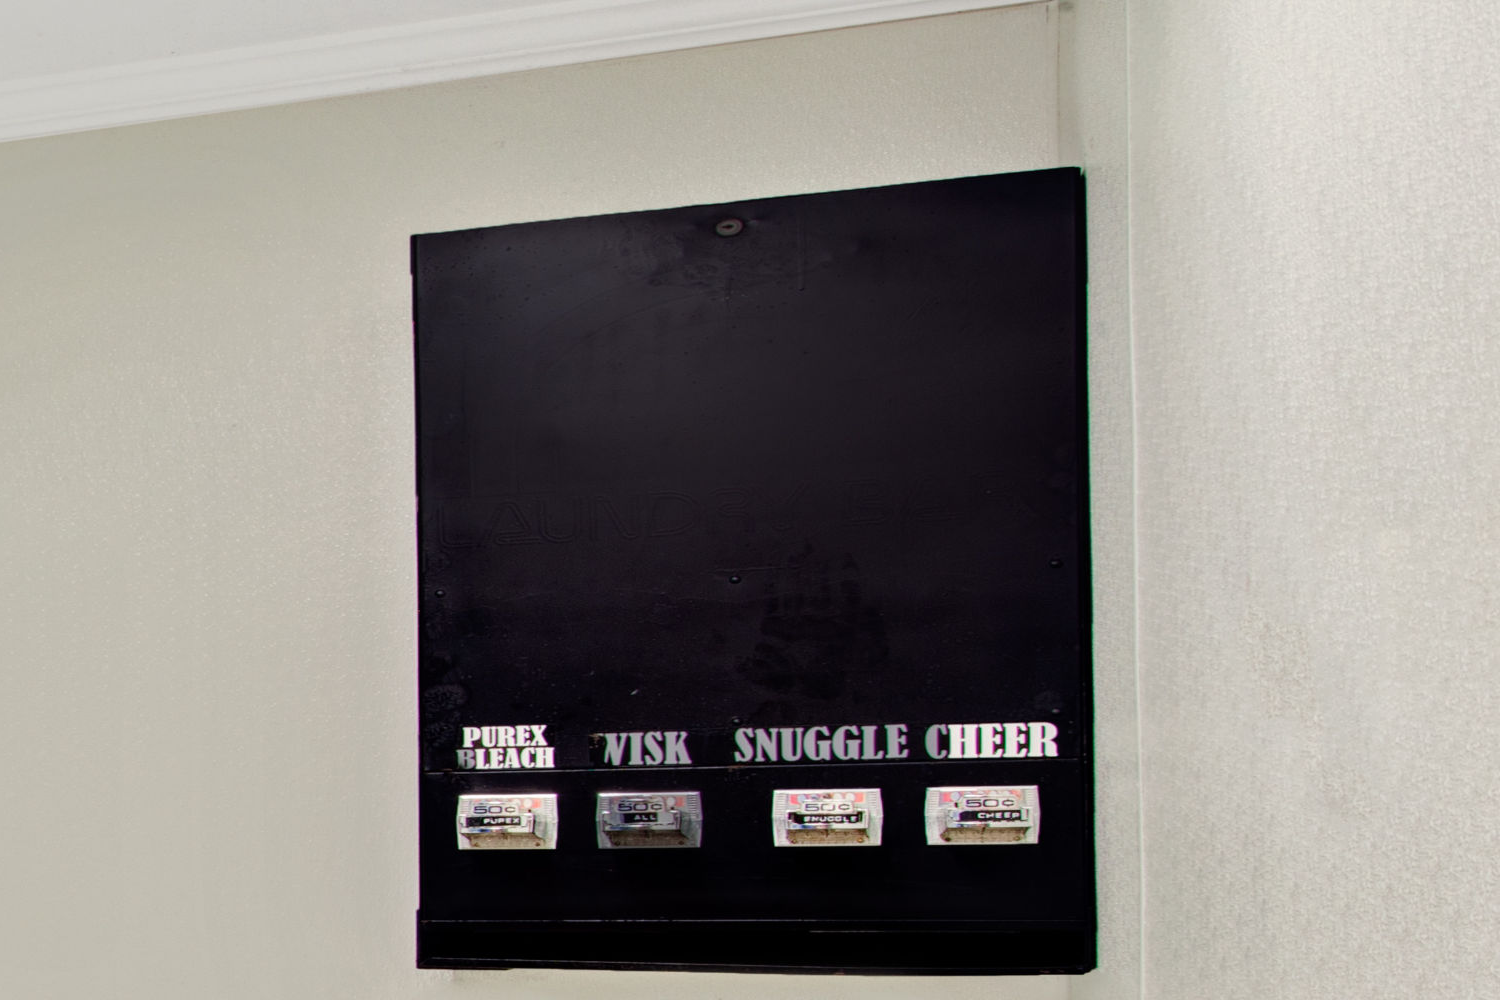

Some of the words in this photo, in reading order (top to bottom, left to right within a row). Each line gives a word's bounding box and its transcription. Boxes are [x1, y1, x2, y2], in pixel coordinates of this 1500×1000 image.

[462, 724, 548, 748] PUREX
[733, 723, 909, 763] SNUGGLE
[925, 720, 1060, 759] CHEER
[457, 746, 555, 770] BLEACH
[483, 817, 520, 825] PUREX
[634, 814, 657, 822] ALL
[803, 815, 859, 823] SNUGGLE
